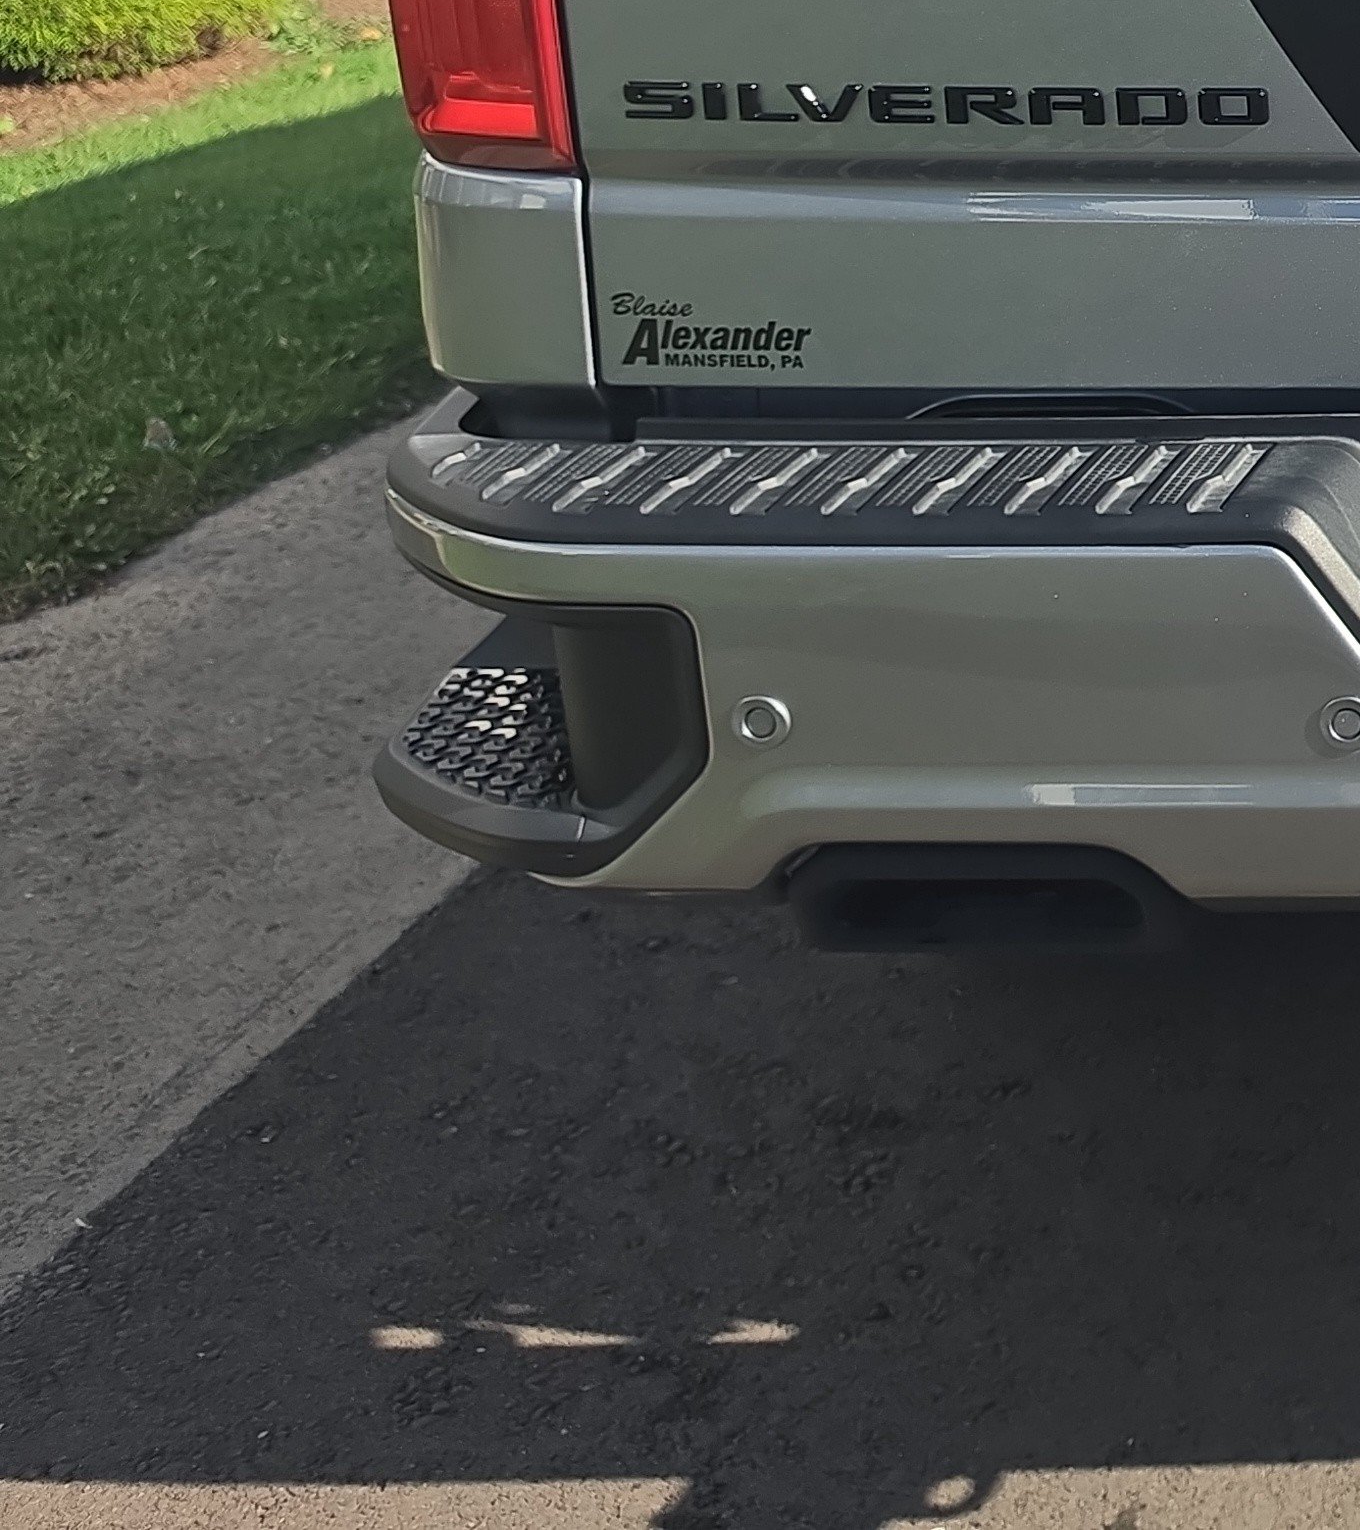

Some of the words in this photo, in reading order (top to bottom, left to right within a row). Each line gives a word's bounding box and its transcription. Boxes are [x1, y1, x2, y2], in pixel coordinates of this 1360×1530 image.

[623, 80, 1271, 126] SILVERADO
[610, 292, 694, 317] Blaise
[621, 318, 812, 365] Alexander
[664, 353, 776, 371] MANSFIELD,
[780, 354, 805, 369] PA
